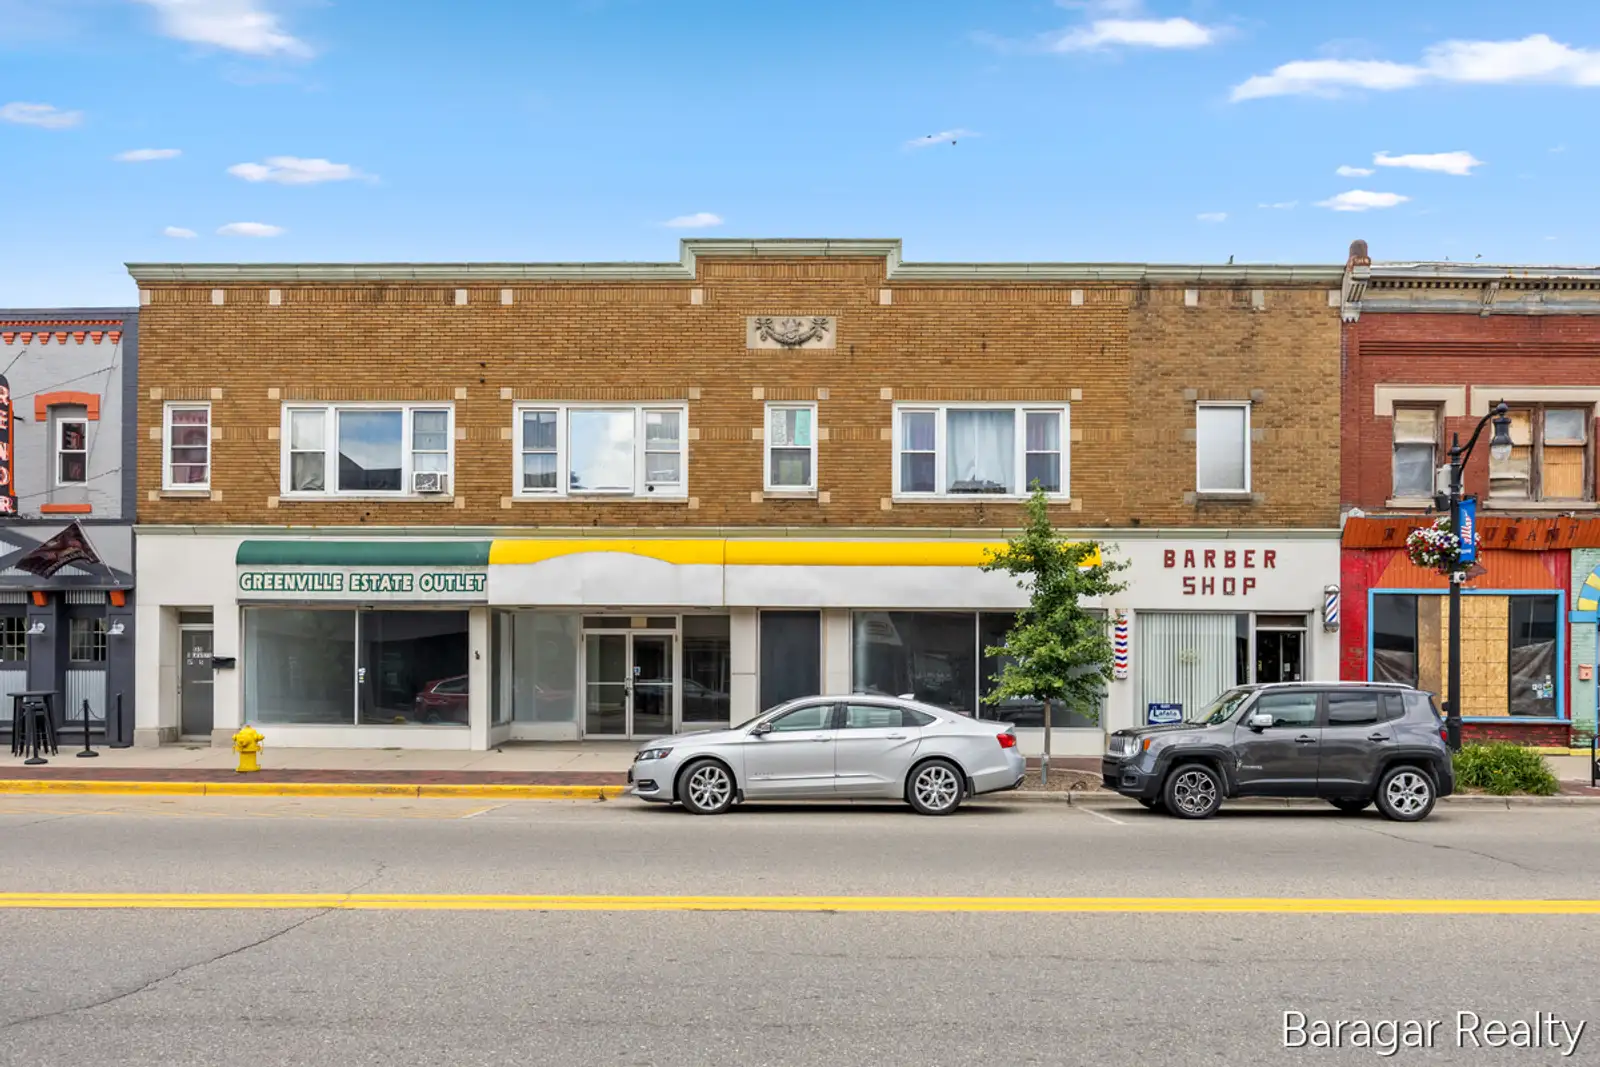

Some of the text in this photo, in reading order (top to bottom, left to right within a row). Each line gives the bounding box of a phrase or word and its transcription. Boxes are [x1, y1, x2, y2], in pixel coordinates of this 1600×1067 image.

[1164, 549, 1277, 569] BARBER
[240, 573, 487, 592] GREENVILLE ESTATE OUTLET
[1183, 576, 1256, 596] SHOP
